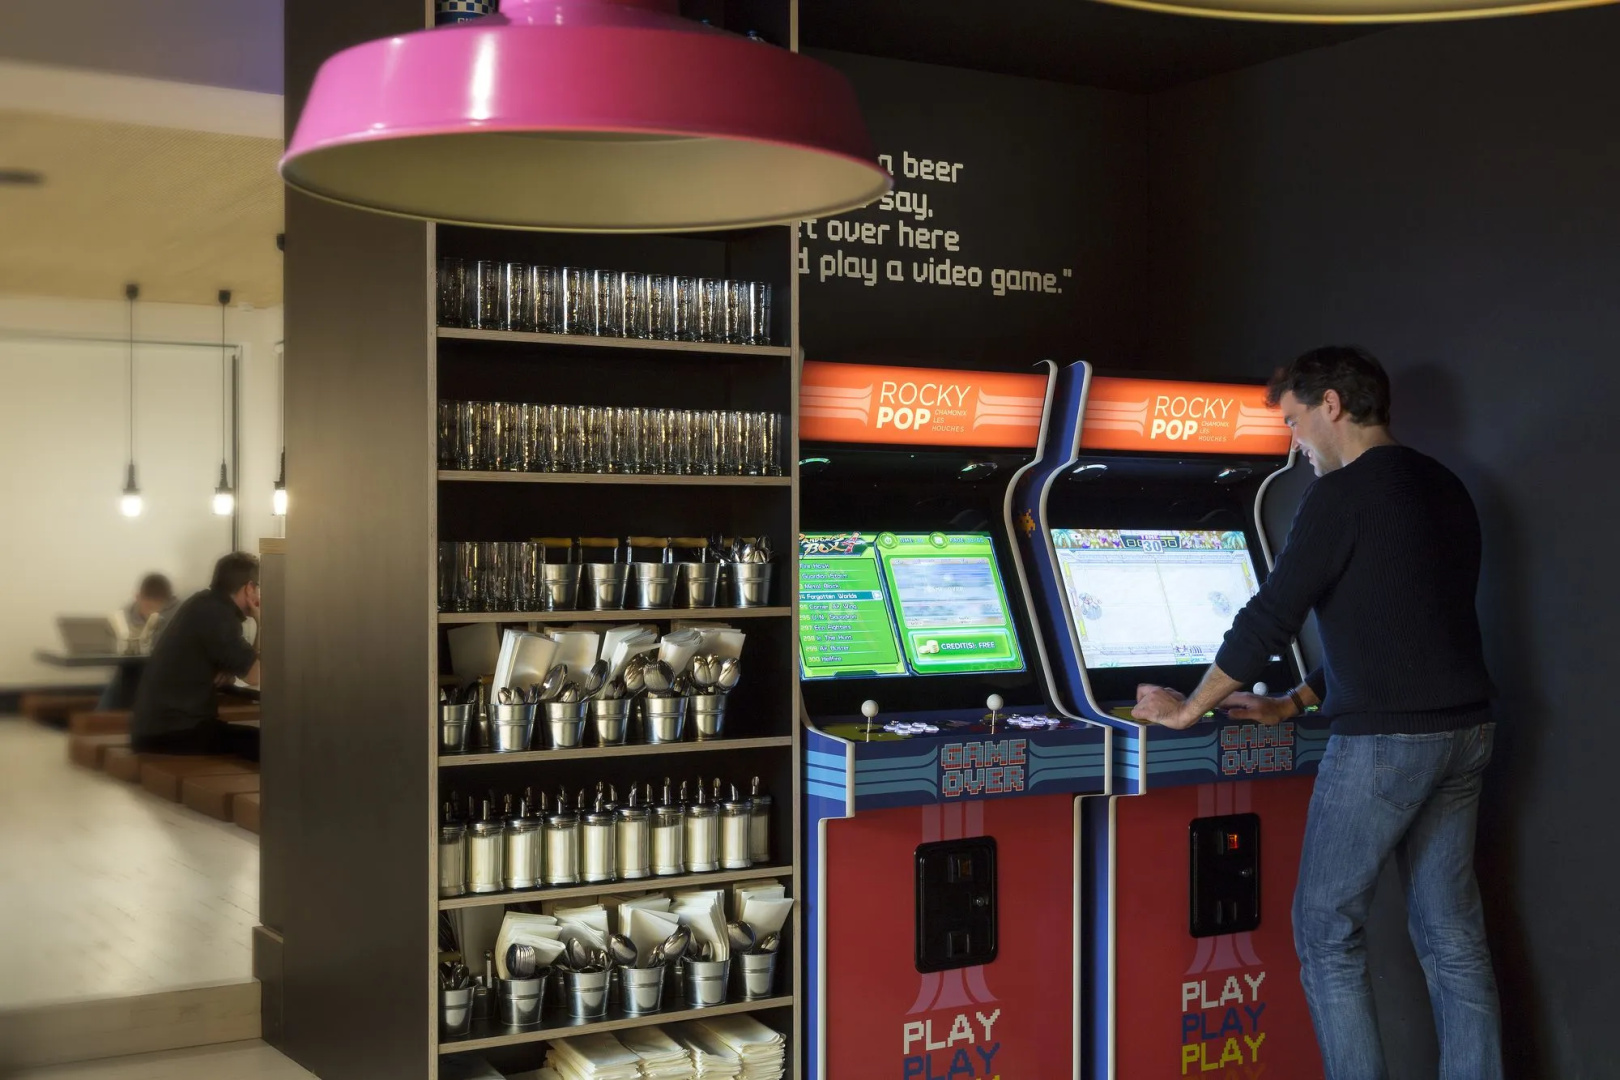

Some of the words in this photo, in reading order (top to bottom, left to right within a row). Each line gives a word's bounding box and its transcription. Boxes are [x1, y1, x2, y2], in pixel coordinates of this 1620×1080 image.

[903, 151, 964, 183] beer
[827, 220, 890, 245] over
[899, 220, 960, 251] here
[820, 250, 877, 286] play
[886, 260, 904, 281] a
[912, 257, 982, 287] video
[991, 268, 1072, 296] game."
[880, 381, 971, 407] ROCKY
[1155, 395, 1234, 419] ROCKY
[876, 406, 931, 430] POP
[934, 408, 967, 416] CHAMONIX
[1201, 420, 1230, 428] CHAMONIX
[1150, 418, 1198, 440] POP
[1143, 540, 1161, 552] 30
[1221, 722, 1294, 750] GAME
[941, 739, 1026, 770] GAME
[1222, 747, 1293, 775] OVER
[942, 765, 1024, 797] OVER
[1182, 971, 1265, 1012] PLAY
[904, 1008, 1000, 1055] PLAY
[1182, 1002, 1266, 1044] PLAY
[904, 1042, 1001, 1080] PLAY
[1182, 1032, 1265, 1075] PLAY
